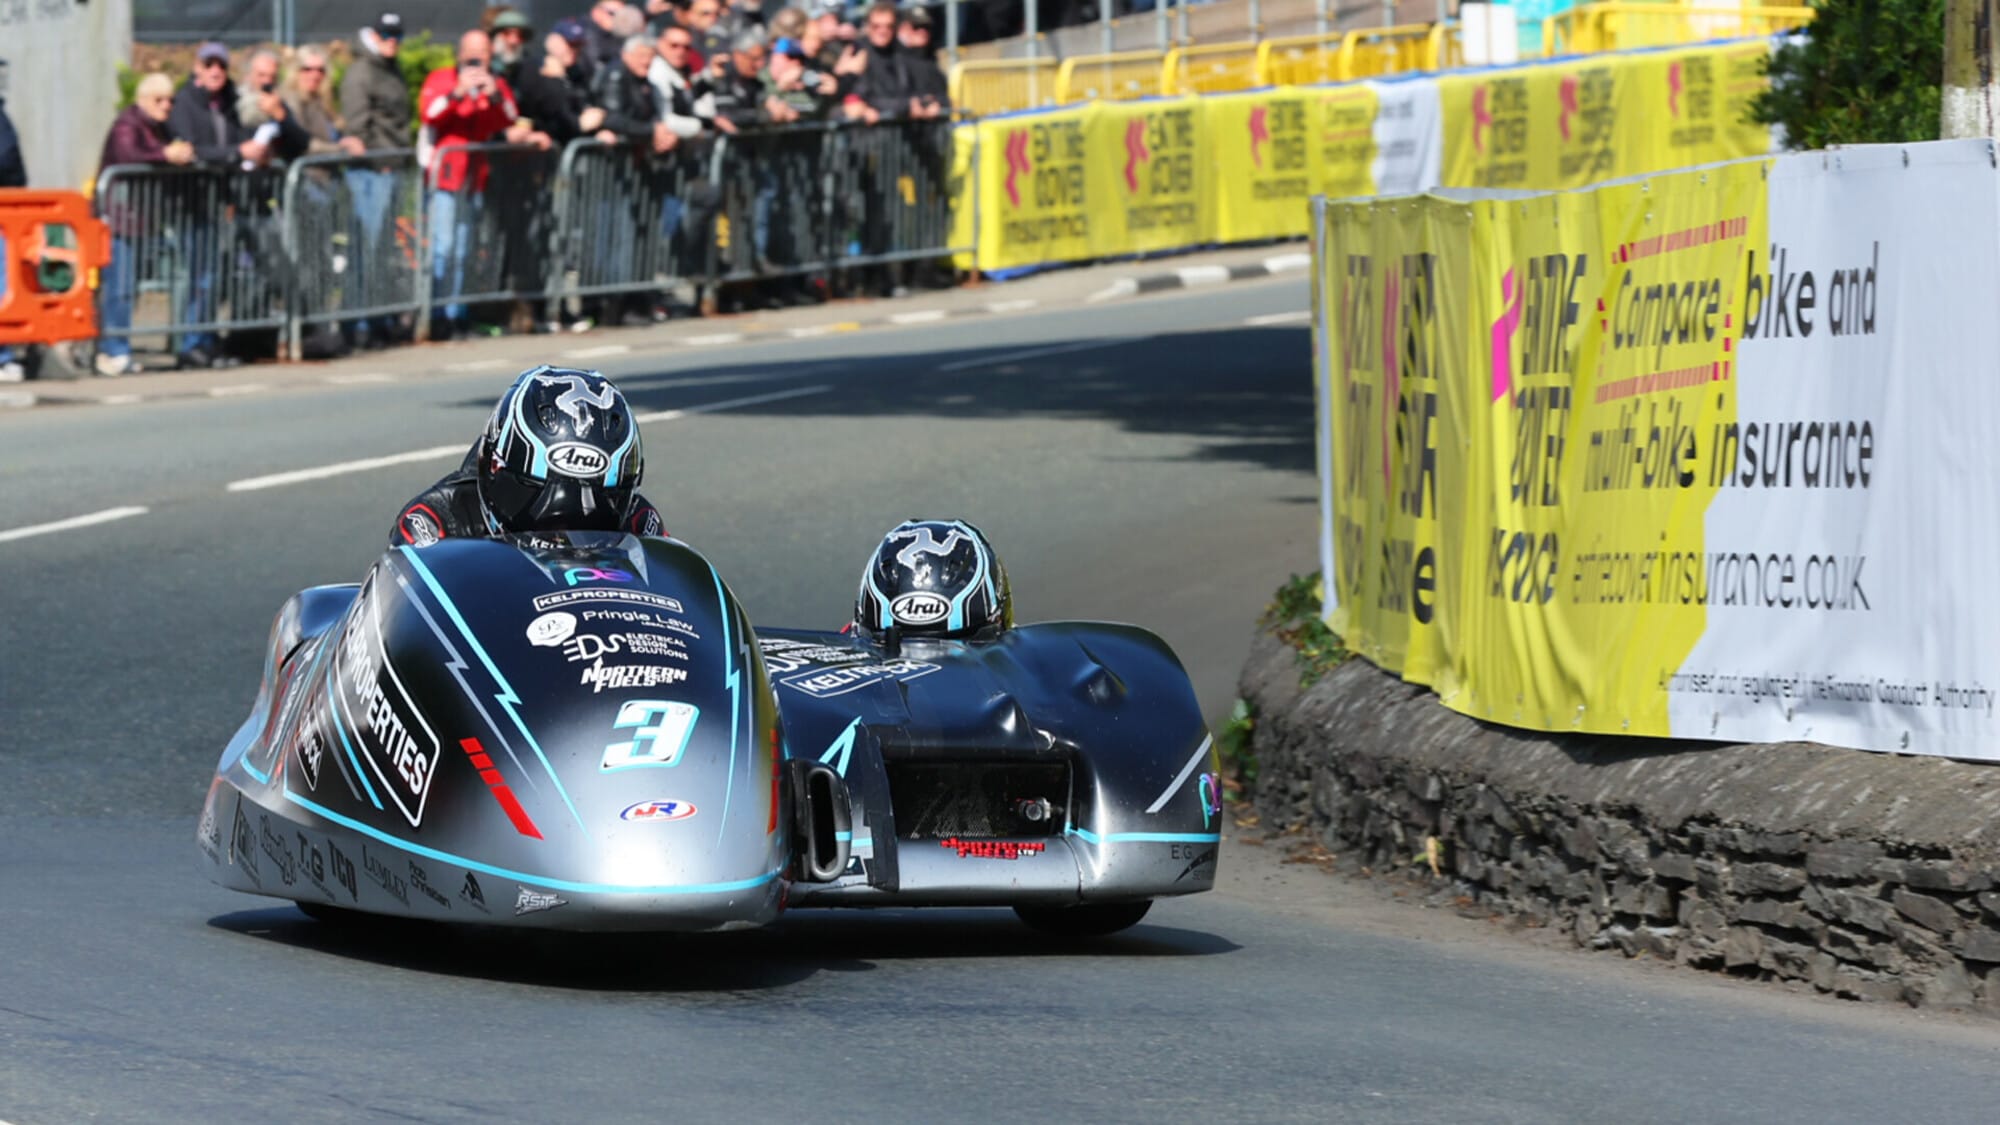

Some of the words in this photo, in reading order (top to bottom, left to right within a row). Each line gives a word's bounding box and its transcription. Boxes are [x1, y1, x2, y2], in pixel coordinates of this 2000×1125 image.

[1614, 269, 1720, 371] Compare
[1741, 243, 1816, 339] bike
[1829, 241, 1879, 336] and
[1709, 393, 1873, 488] insurance
[553, 447, 602, 468] Arai
[539, 588, 679, 610] KELPROPERTIES
[895, 597, 941, 615] Arai
[582, 609, 651, 622] Pringle
[655, 613, 694, 631] Law
[625, 632, 687, 648] ELECTRICAL
[628, 639, 668, 650] DESIGN
[630, 646, 689, 660] SOLUTIONS
[581, 662, 688, 685] NORTHERN
[1876, 678, 1928, 707] Conduct
[1933, 680, 1996, 718] Authority
[599, 700, 700, 774] 3
